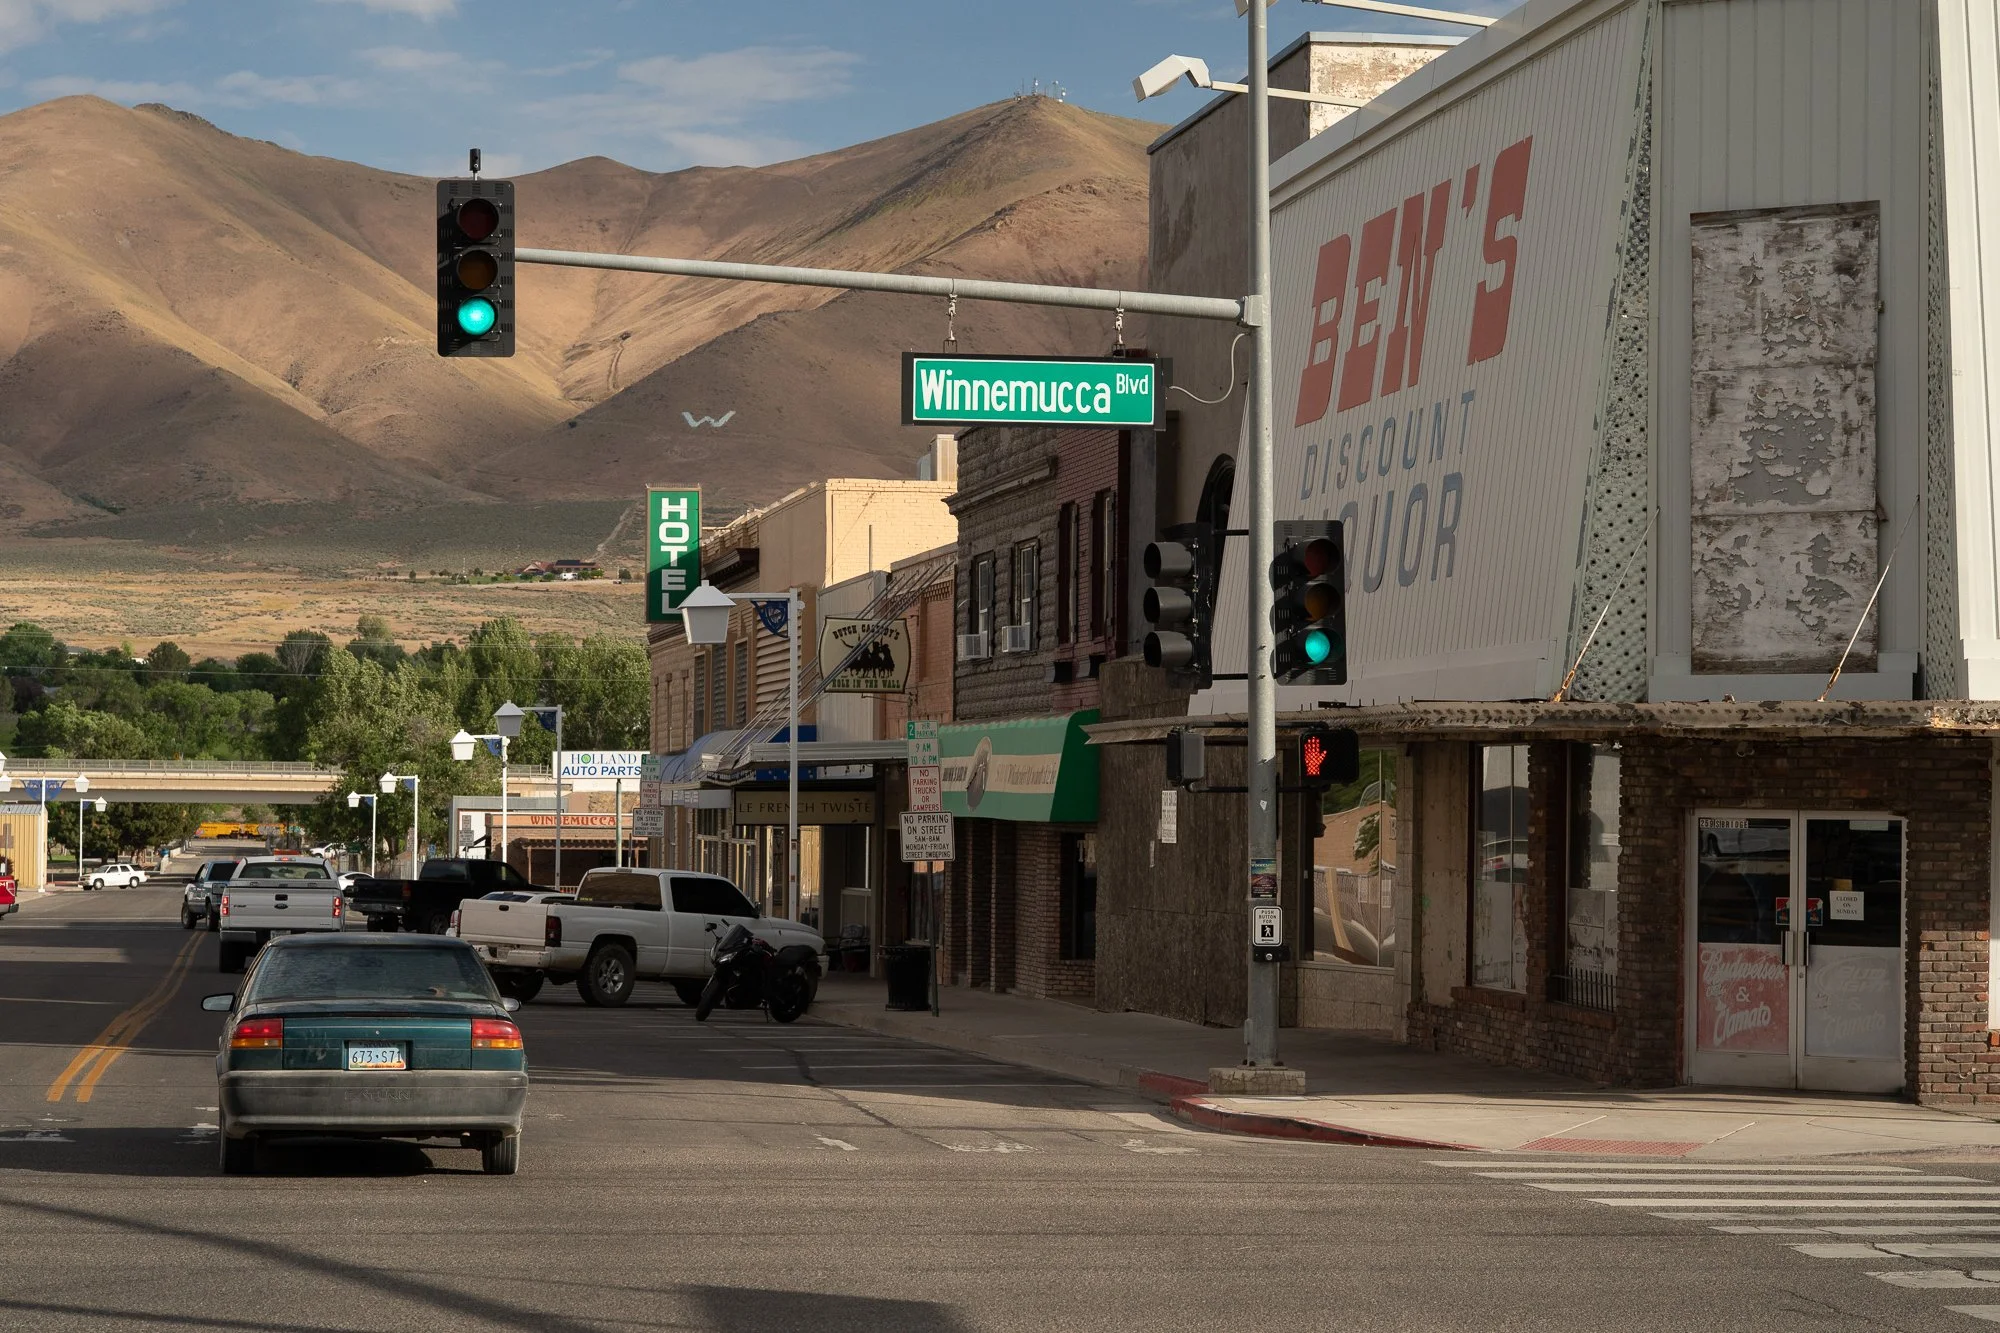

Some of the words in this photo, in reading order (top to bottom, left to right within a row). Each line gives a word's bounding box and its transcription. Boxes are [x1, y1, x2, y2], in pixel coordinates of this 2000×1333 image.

[1295, 134, 1534, 428] BEN'S
[920, 369, 1111, 414] Winnemucca
[1116, 373, 1149, 395] Blvd
[1301, 389, 1475, 500] DISCOUNT
[1299, 471, 1463, 594] QUOR
[659, 497, 690, 614] HOTEL
[832, 625, 857, 640] BUTCH
[832, 679, 850, 688] HOLE
[853, 679, 860, 688] IN
[865, 679, 878, 688] THE
[882, 679, 901, 689] WALL
[909, 723, 914, 736] 2
[916, 743, 920, 752] 9
[922, 743, 931, 752] AM
[571, 753, 637, 765] HOLLAND
[911, 756, 918, 765] TO
[922, 756, 926, 765] 6
[928, 755, 937, 765] PM
[562, 766, 598, 776] AUTO
[601, 766, 641, 776] PARTS
[919, 769, 929, 777] NO
[912, 778, 938, 786] PARKING
[914, 787, 937, 795] TRUCKS
[921, 795, 930, 803] OR
[738, 802, 753, 813] LE
[822, 802, 871, 813] TWISTE
[904, 815, 914, 824] NO
[918, 814, 949, 824] PARKING
[1700, 819, 1714, 828] 259
[1715, 819, 1720, 828] S
[1721, 820, 1748, 829] BRIDGE
[907, 826, 917, 835] ON
[921, 825, 947, 835] STREET
[905, 843, 950, 851] MONDAY-FRIDAY
[905, 851, 923, 859] STREET
[925, 851, 951, 859] SWEEPING
[1701, 950, 1786, 984] Budweiser
[1735, 986, 1751, 1002] &
[1713, 998, 1771, 1047] Clamato
